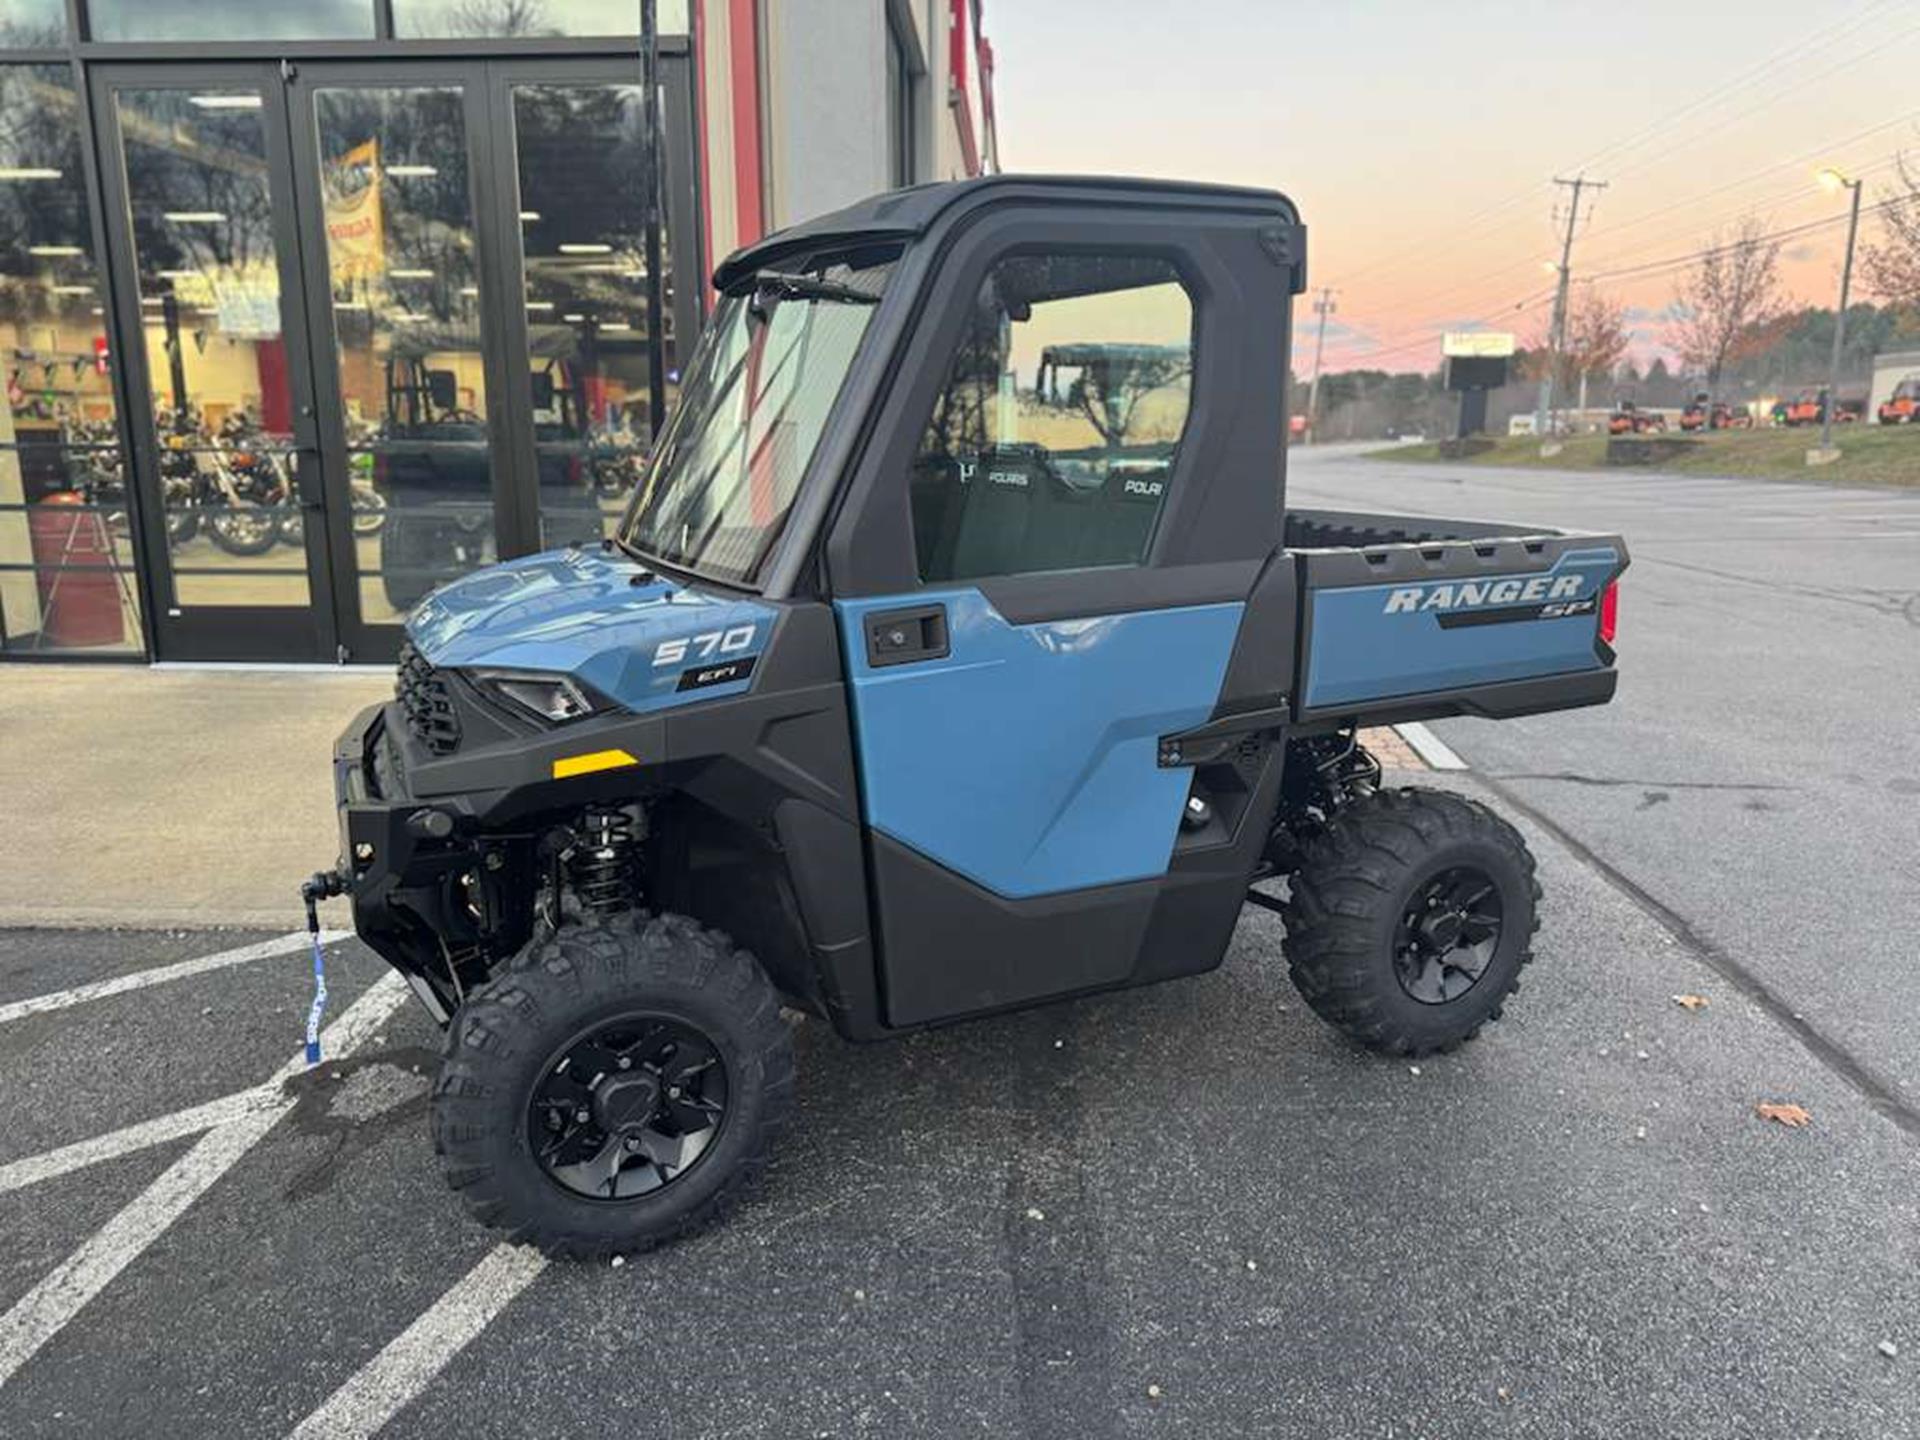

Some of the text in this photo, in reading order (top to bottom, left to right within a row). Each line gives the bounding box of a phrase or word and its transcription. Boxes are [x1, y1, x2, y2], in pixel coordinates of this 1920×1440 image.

[1383, 574, 1584, 614] RANGER
[1538, 600, 1594, 618] SP
[651, 625, 757, 667] 570
